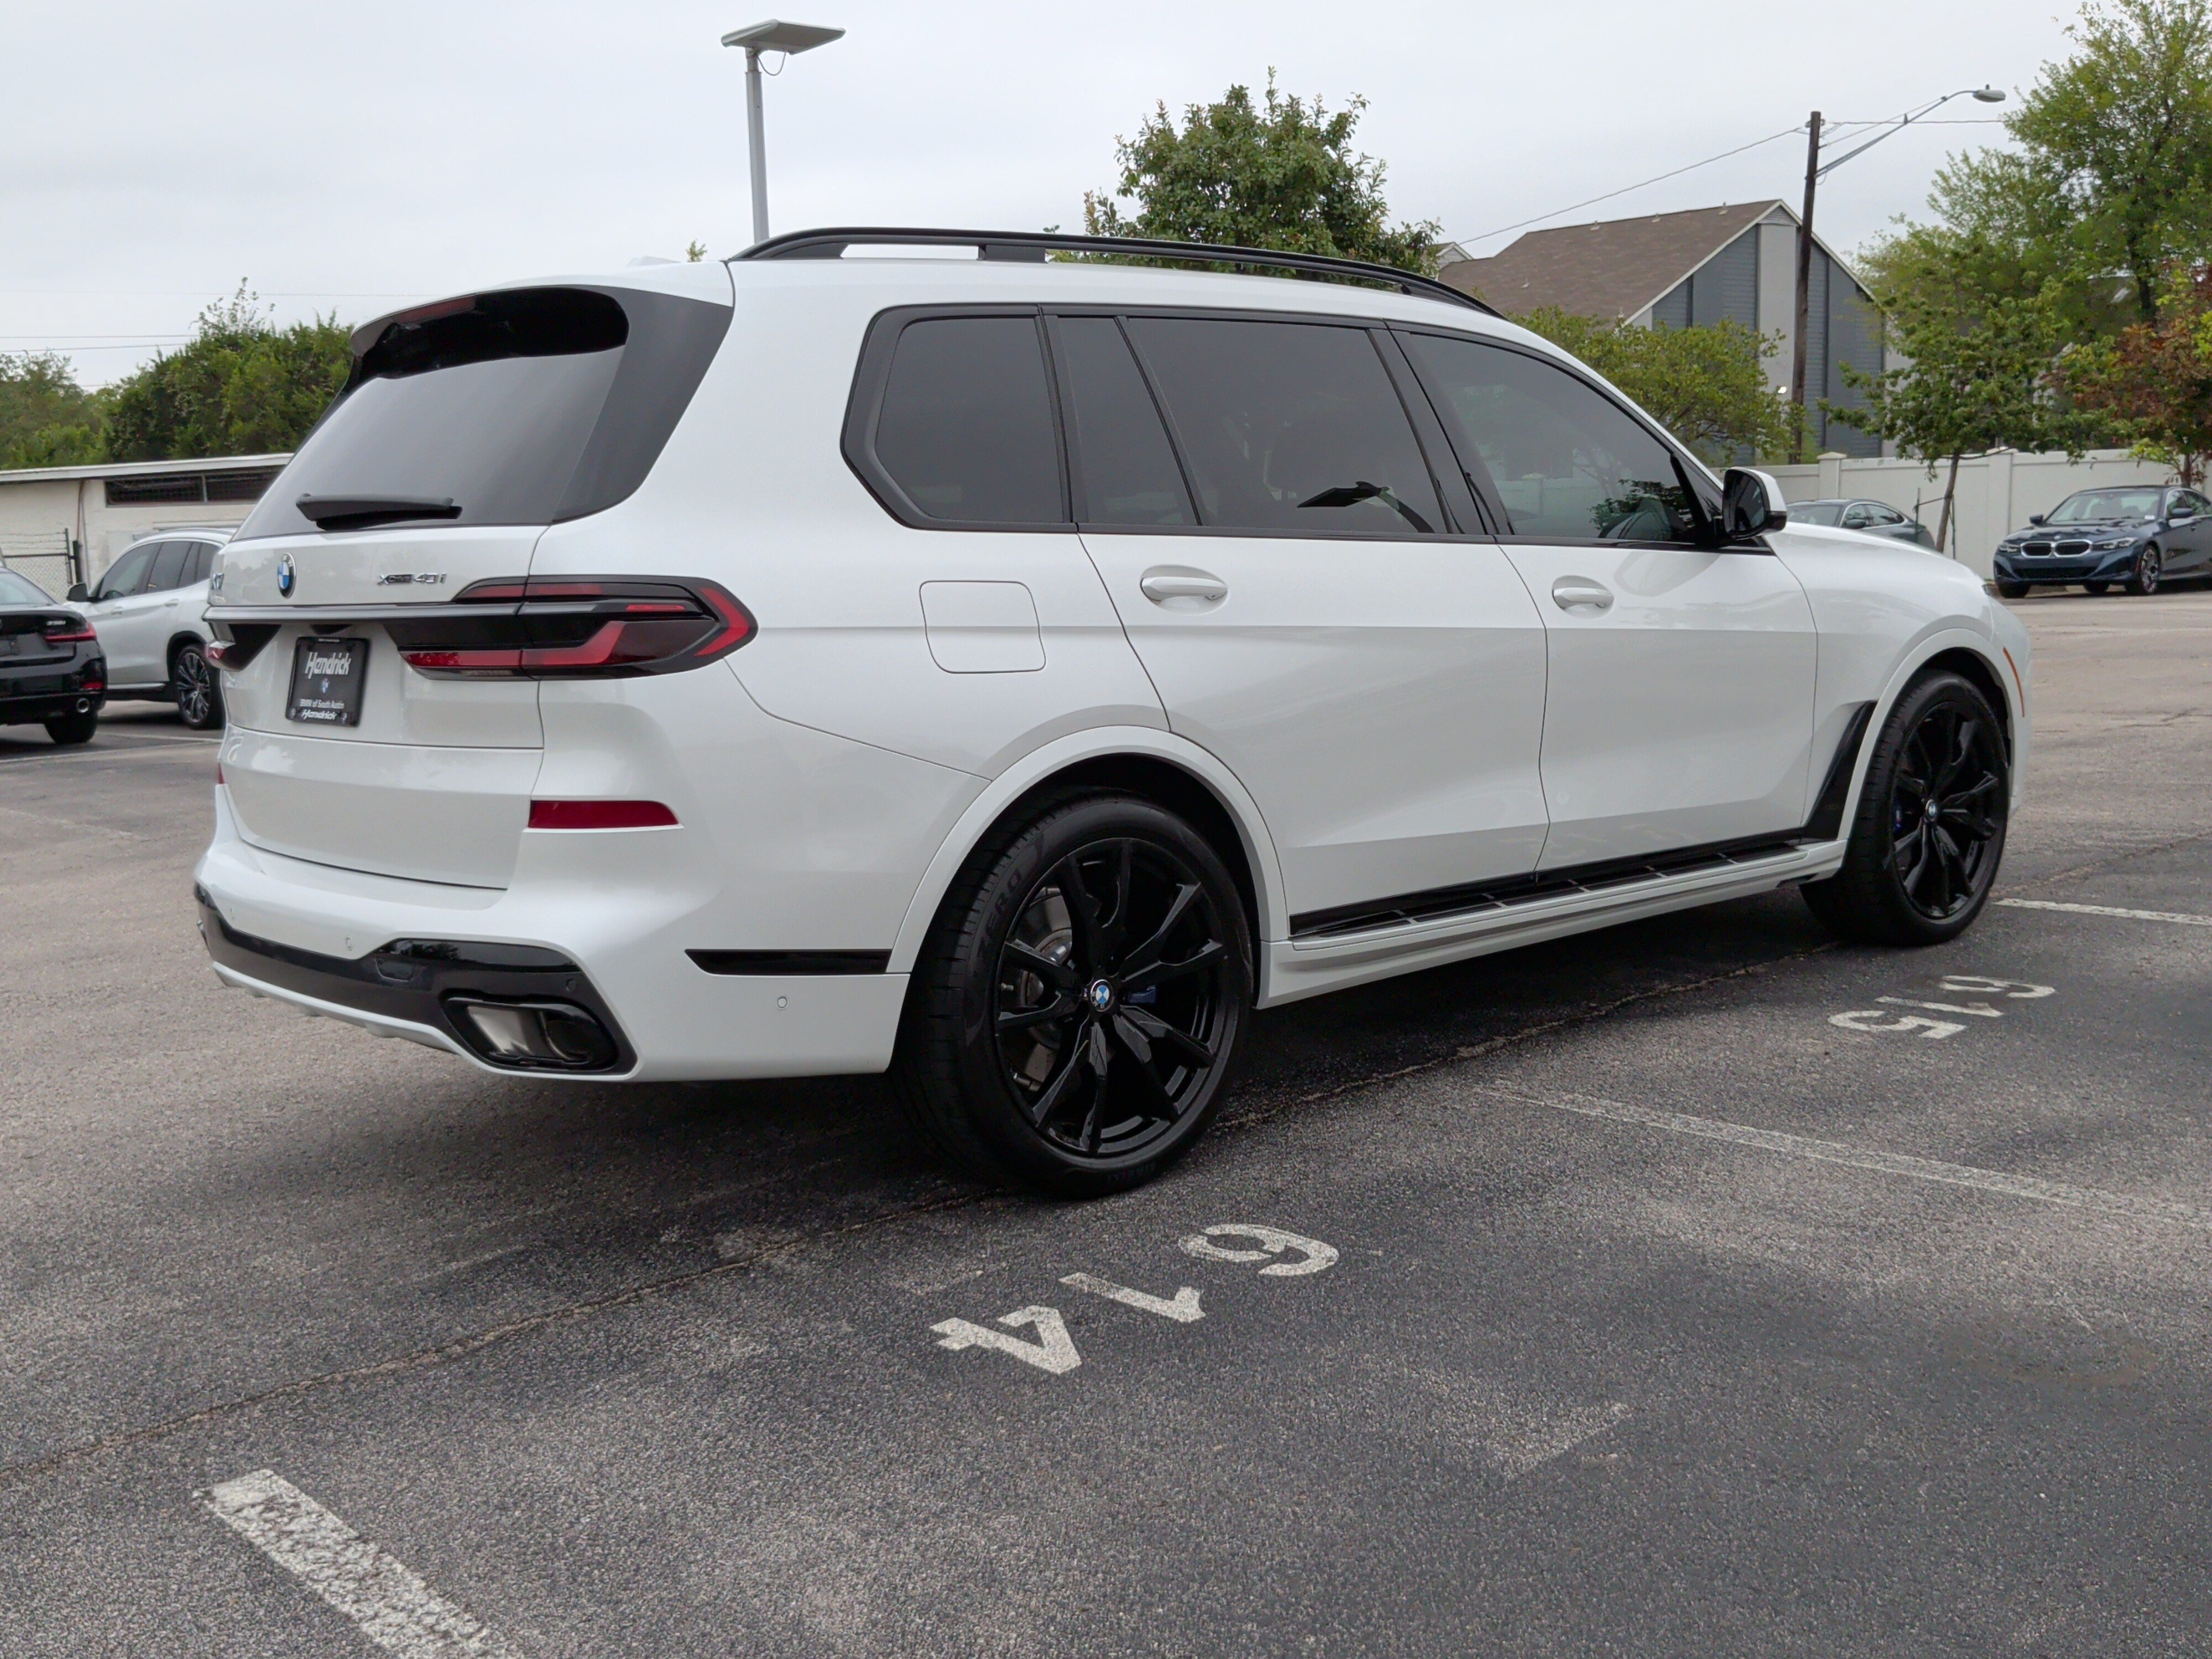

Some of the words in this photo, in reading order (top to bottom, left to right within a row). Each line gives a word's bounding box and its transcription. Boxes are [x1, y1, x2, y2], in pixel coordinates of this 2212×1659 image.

[305, 651, 352, 679] Hendrick
[301, 709, 337, 720] Hendrick
[1827, 975, 2056, 1039] 615
[929, 1223, 1339, 1375] 614
